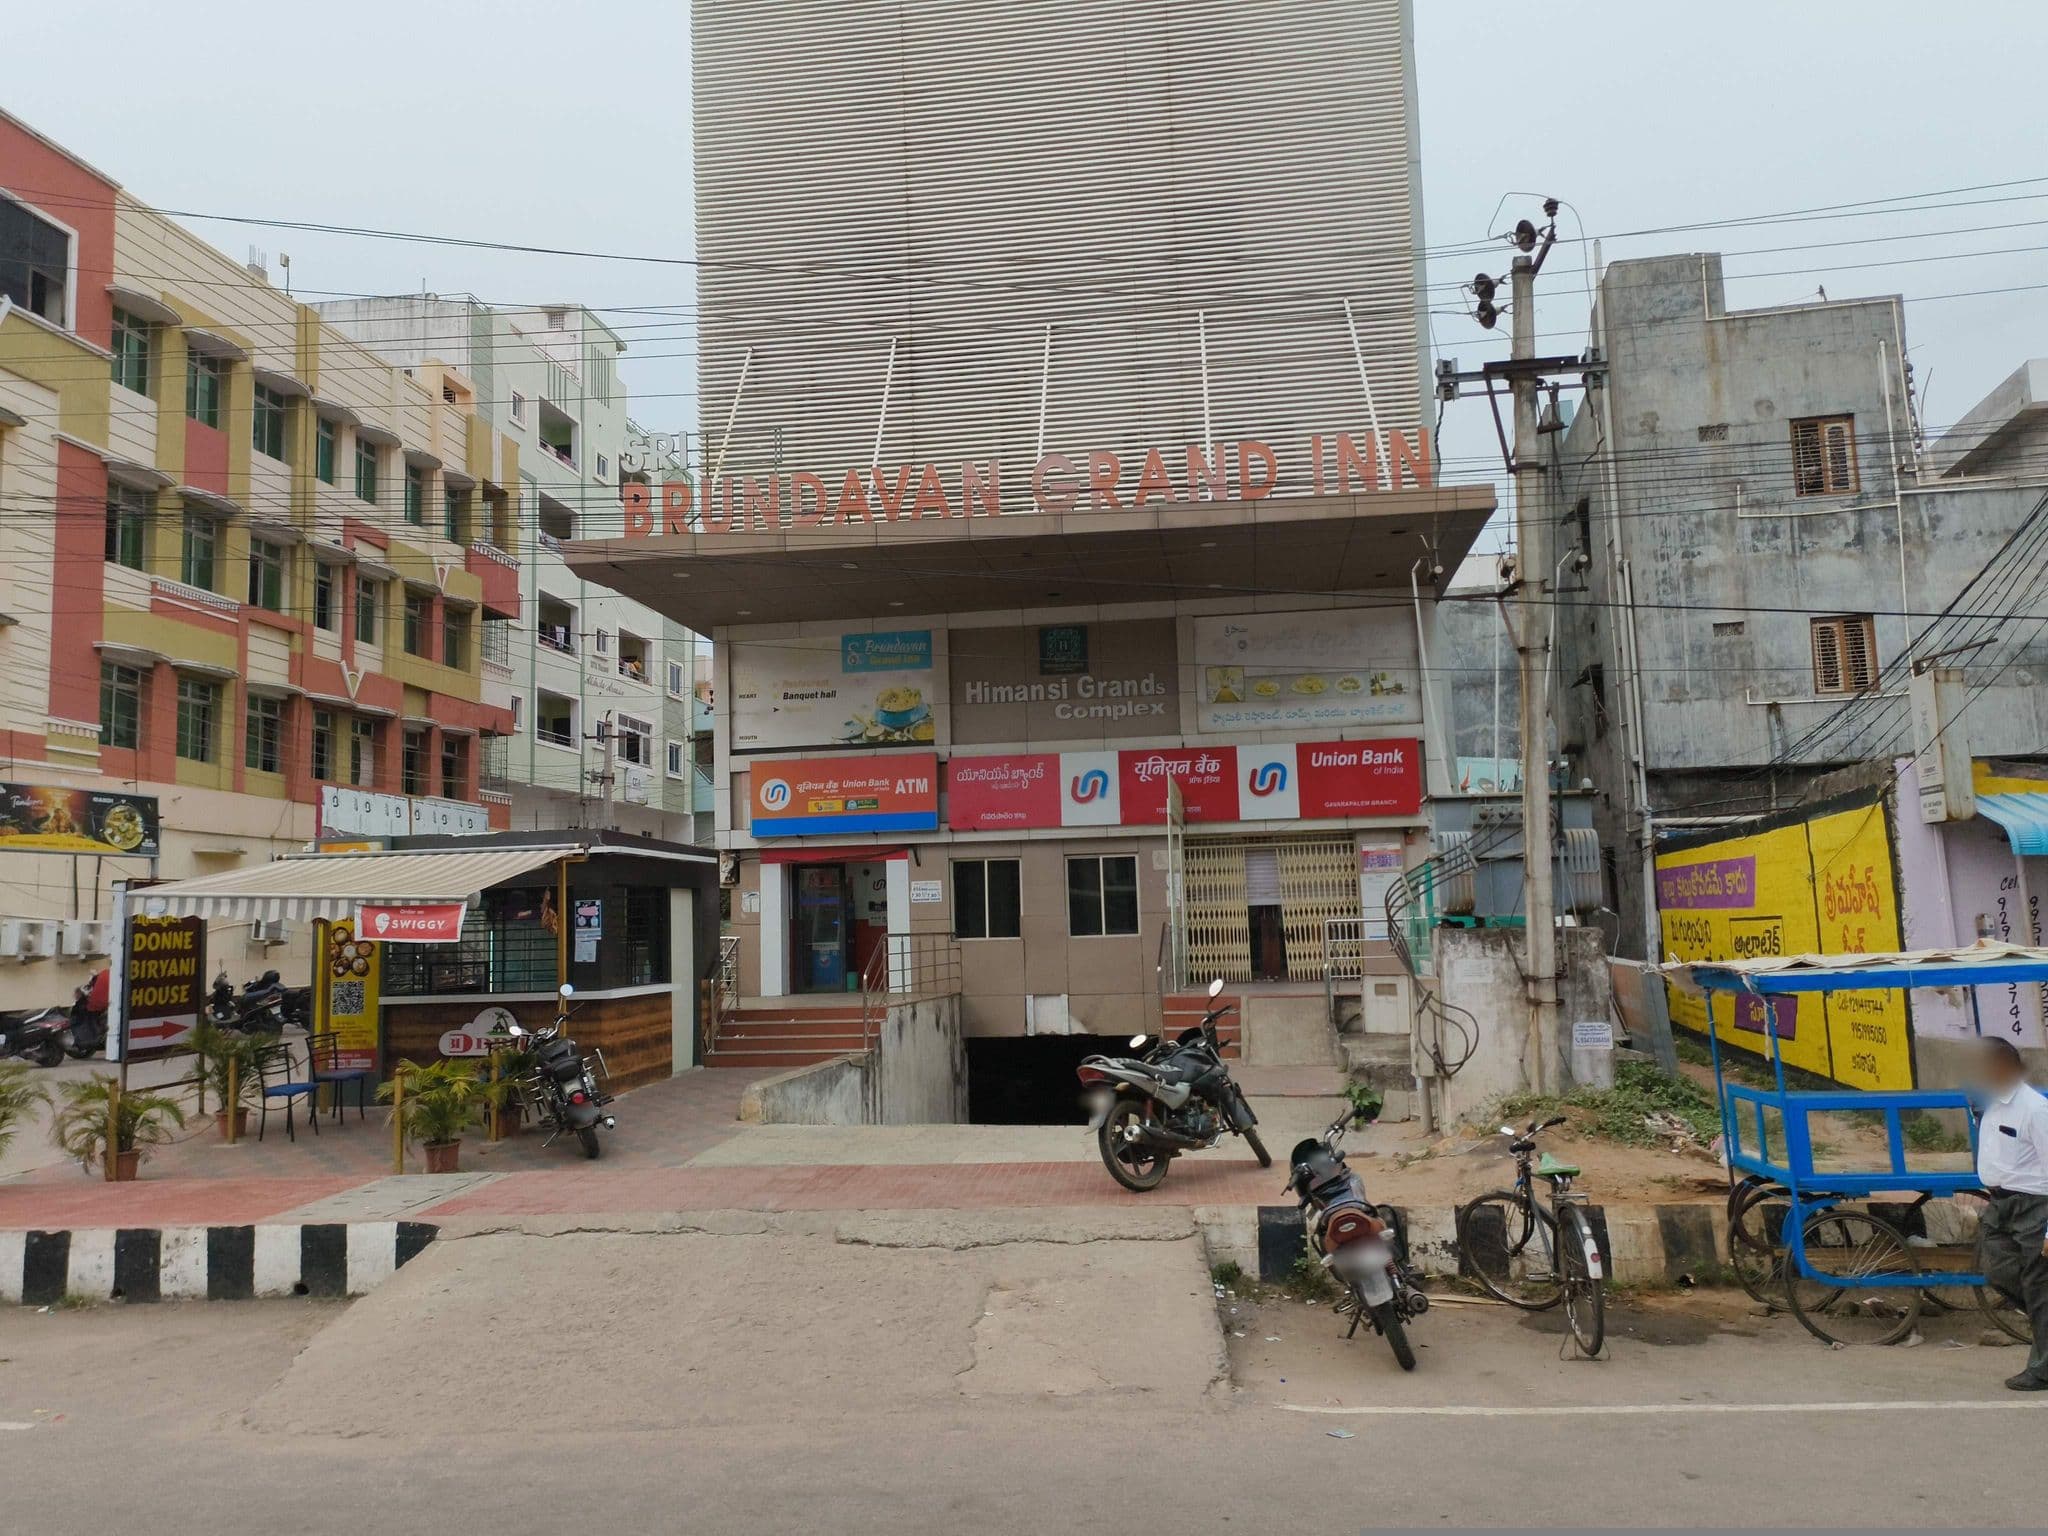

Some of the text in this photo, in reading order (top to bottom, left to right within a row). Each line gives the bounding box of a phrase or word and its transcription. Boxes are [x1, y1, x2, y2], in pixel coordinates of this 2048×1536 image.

[621, 431, 688, 473] SRI
[623, 426, 1434, 540] BRUNDAVAN GRAND INN
[865, 637, 927, 655] Brundavan
[783, 689, 838, 702] Banquet hall
[965, 673, 1166, 704] Himansi Grands
[1054, 701, 1166, 721] Complex
[1134, 753, 1222, 782] यूनियन बैंक
[1311, 748, 1404, 768] Union Bank
[957, 763, 1010, 782] యూనియన్
[1373, 766, 1404, 775] of India
[842, 777, 928, 795] Union Bank ATM
[1371, 799, 1397, 807] BRANCH
[400, 908, 417, 916] Order
[392, 919, 446, 930] SWIGGY
[133, 930, 194, 952] DONNE
[129, 956, 196, 981] BIRYANI
[131, 984, 191, 1007] HOUSE
